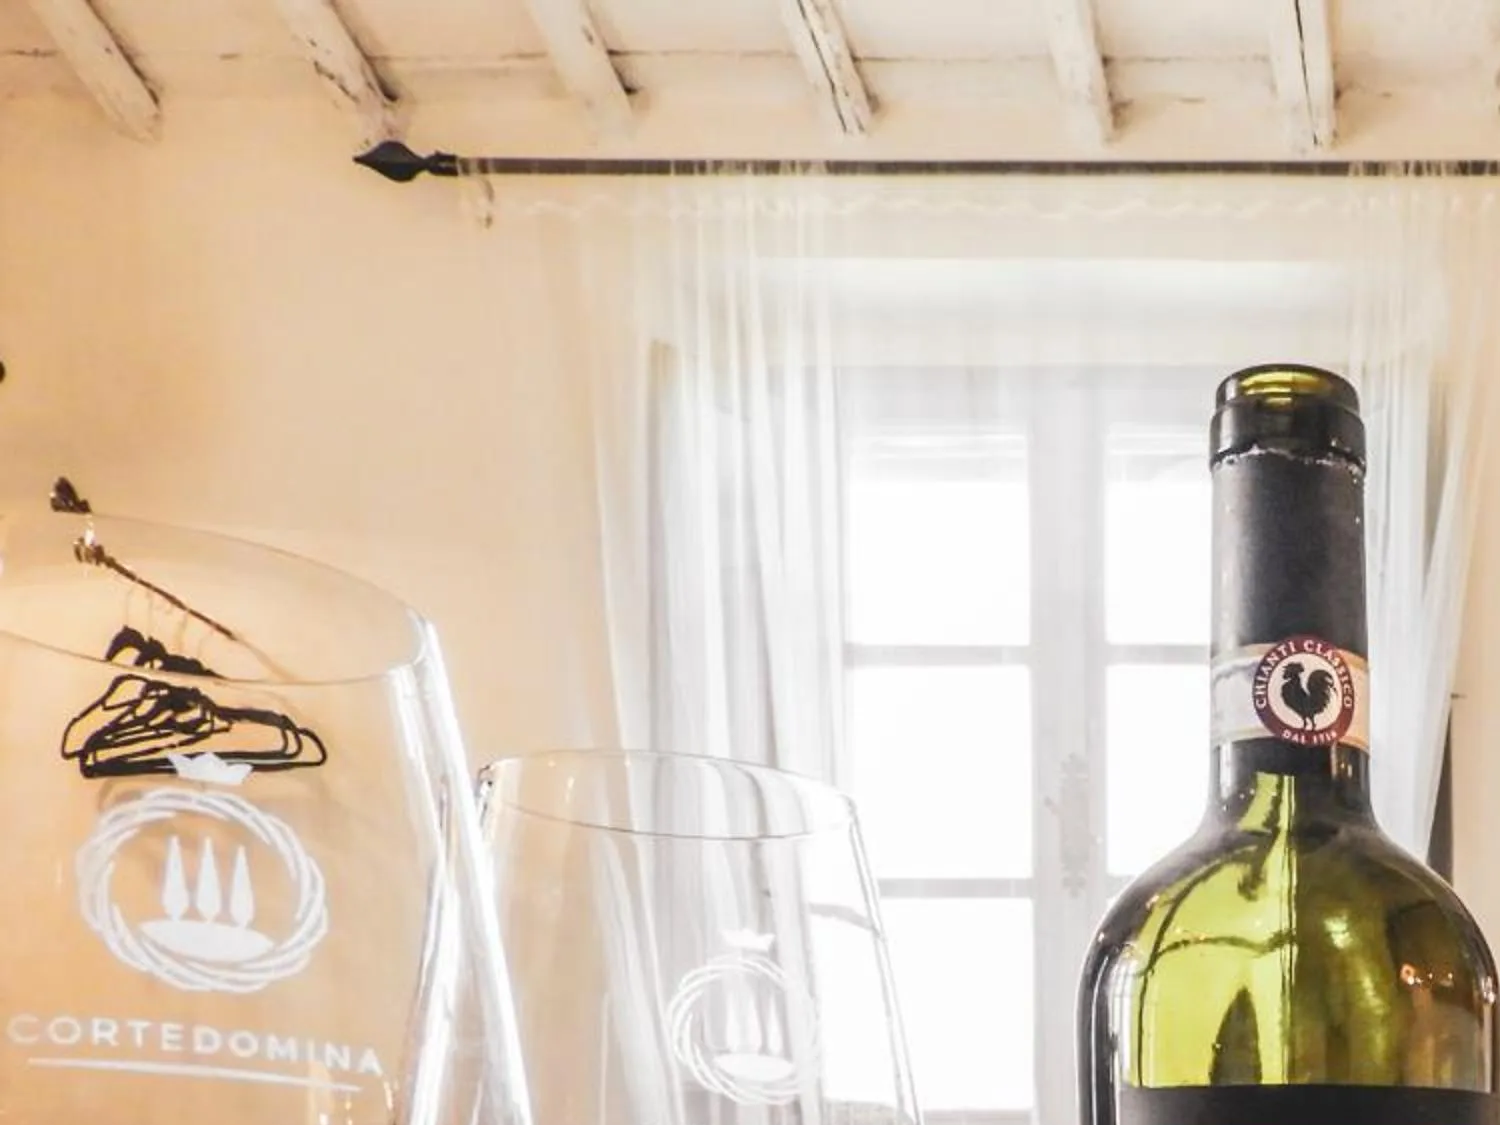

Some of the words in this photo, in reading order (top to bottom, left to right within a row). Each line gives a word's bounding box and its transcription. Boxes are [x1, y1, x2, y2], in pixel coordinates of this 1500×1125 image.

[1255, 641, 1296, 710] CHIANTI
[1303, 639, 1353, 708] CLASSICO
[1282, 729, 1306, 744] DAL
[7, 1014, 384, 1076] CORTEDOMINA
